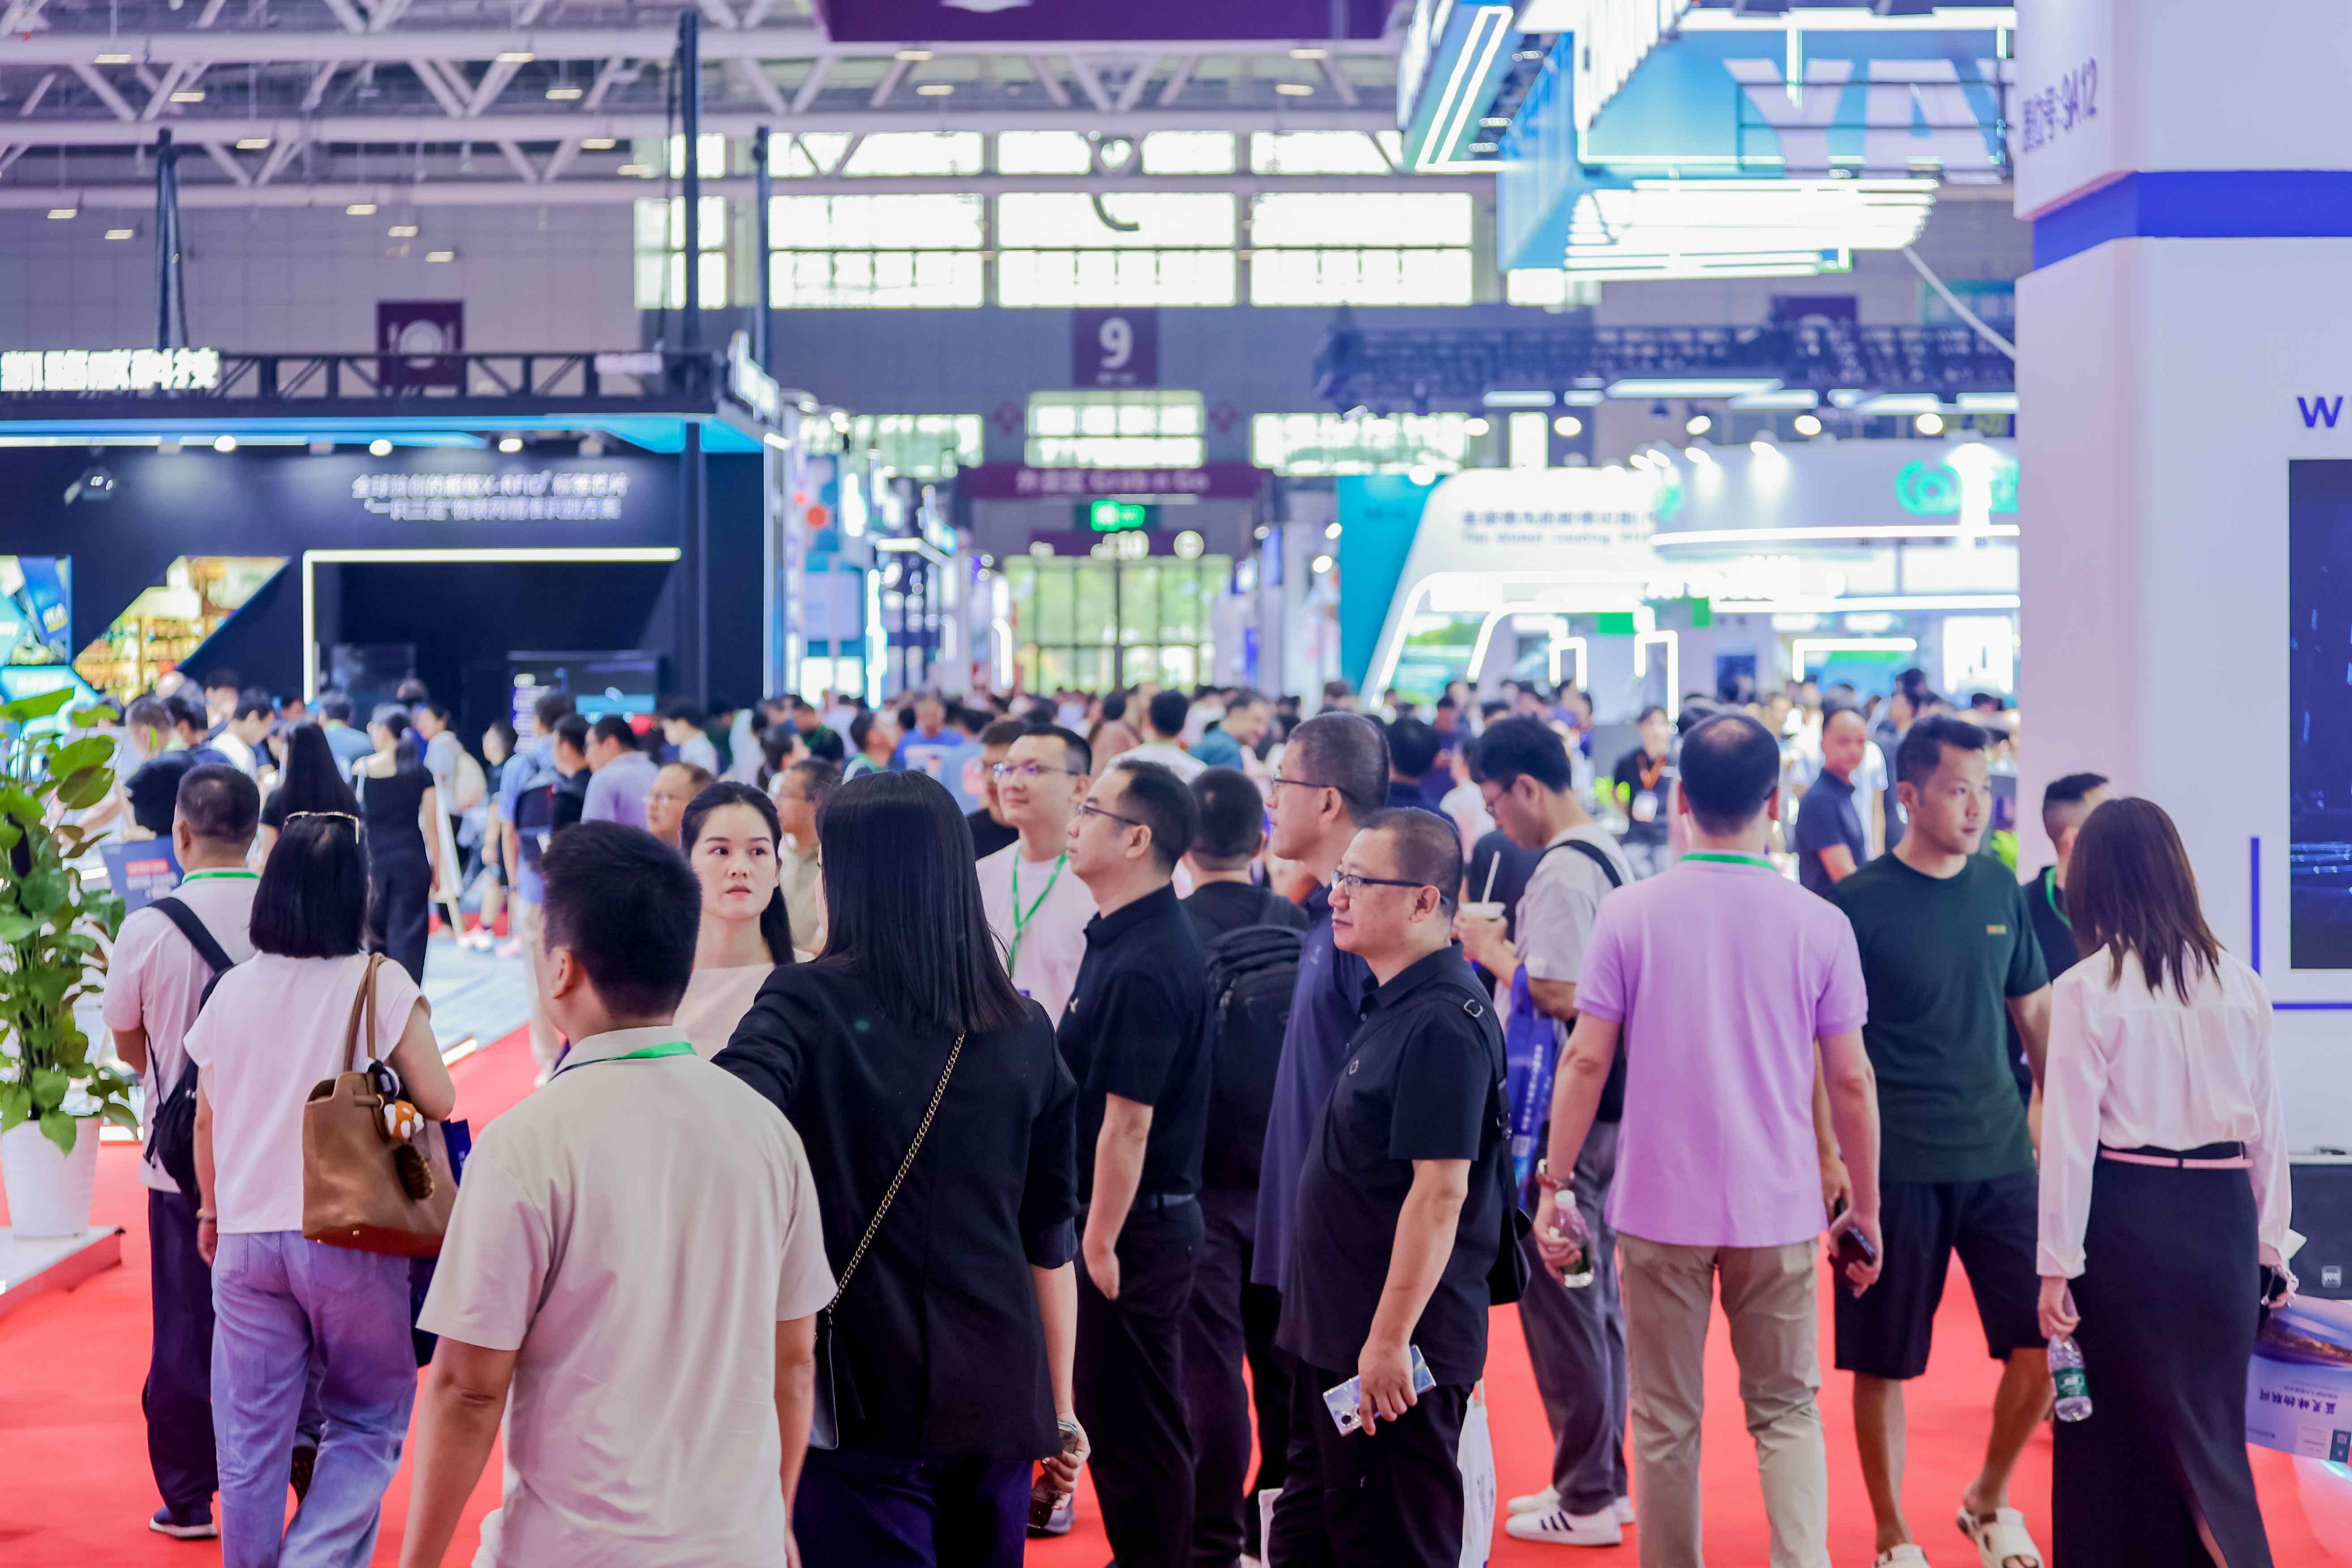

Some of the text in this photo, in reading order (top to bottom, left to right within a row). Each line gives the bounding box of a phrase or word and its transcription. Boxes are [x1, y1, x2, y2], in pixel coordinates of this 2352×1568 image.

[1722, 58, 2016, 184] YA
[1099, 317, 1133, 369] 9
[2297, 396, 2352, 428] W
